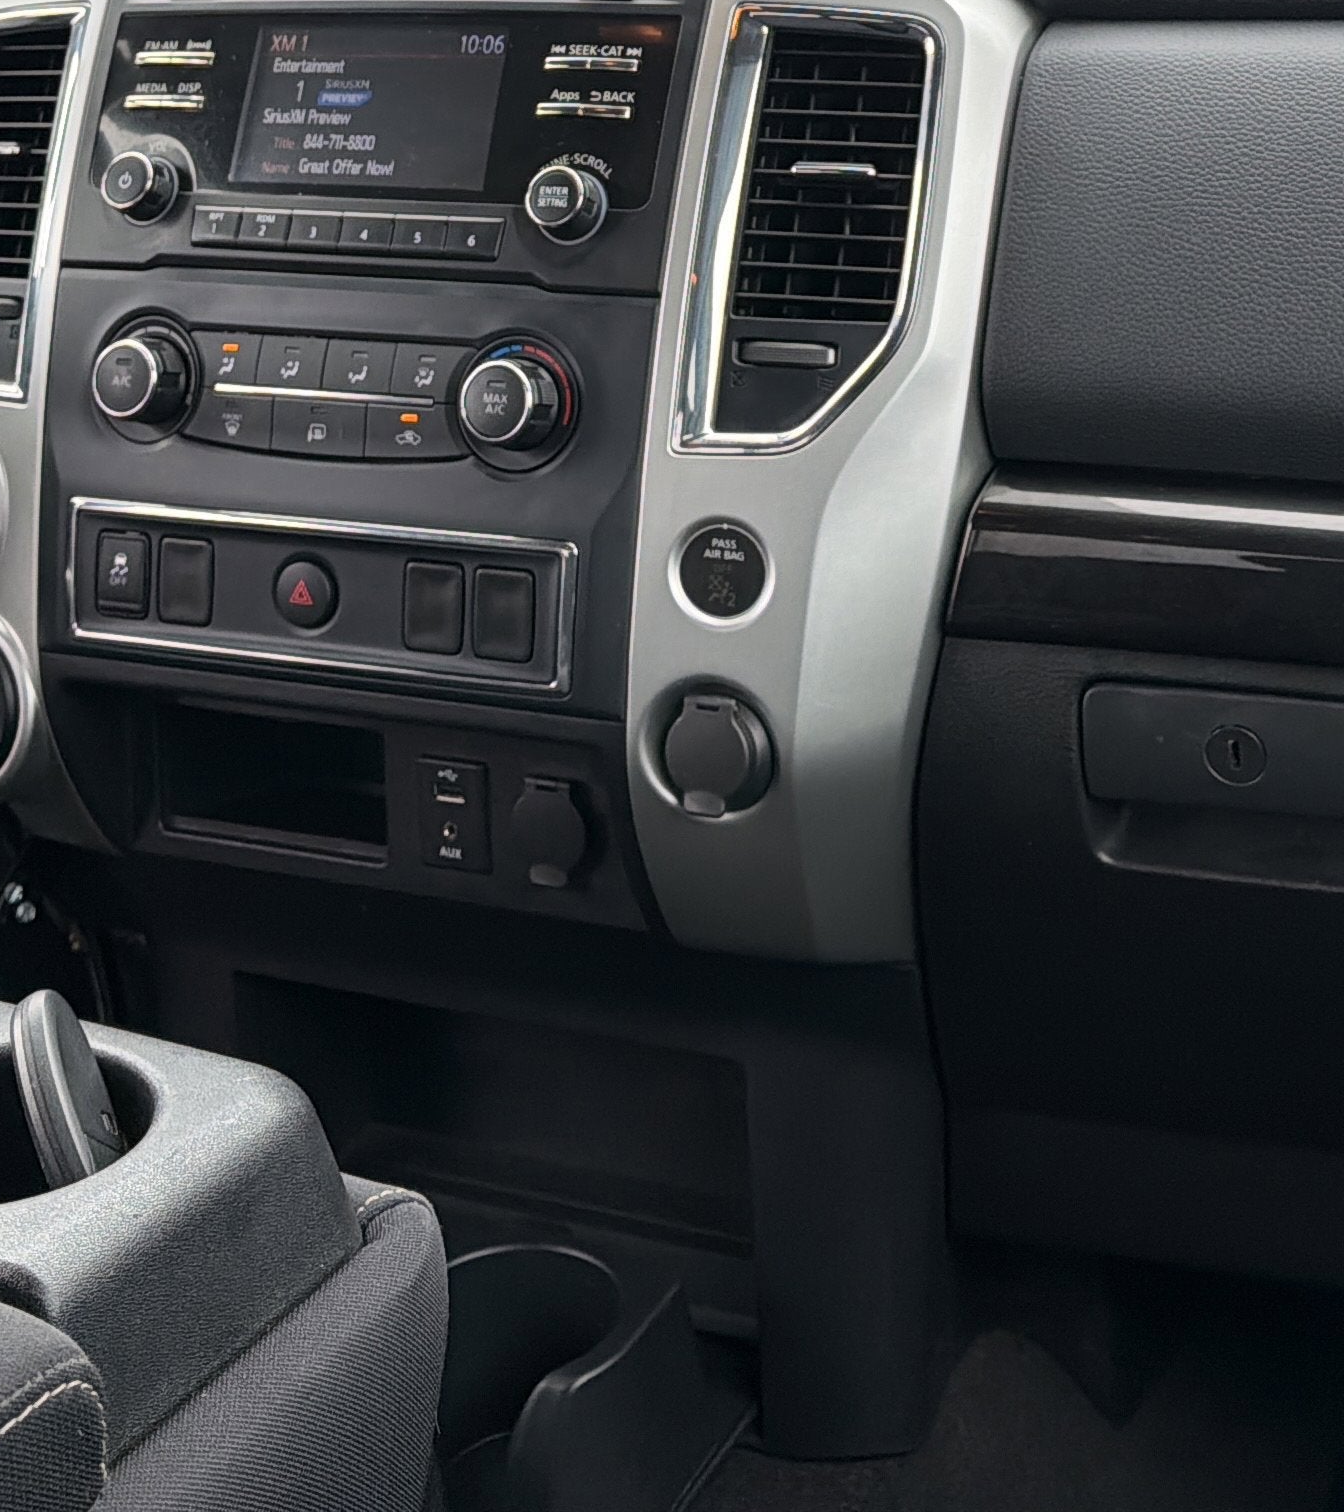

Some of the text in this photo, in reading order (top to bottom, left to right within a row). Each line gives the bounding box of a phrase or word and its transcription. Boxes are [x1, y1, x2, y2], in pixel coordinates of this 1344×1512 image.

[271, 35, 296, 52] XM
[460, 35, 505, 54] 10:06
[273, 57, 345, 74] Entertainment
[135, 83, 168, 93] MEDIA
[297, 80, 305, 102] 1
[550, 88, 580, 101] Apps
[602, 91, 636, 103] BACK
[263, 108, 351, 126] SiriusXM Preview
[303, 134, 376, 151] 844-711-8800
[298, 157, 329, 175] Great
[333, 158, 364, 176] Offer
[366, 160, 395, 177] Now!
[539, 186, 568, 196] ENTER
[537, 198, 568, 208] SETTING
[211, 223, 217, 234] 1
[258, 224, 267, 237] 2
[309, 226, 317, 239] 3
[360, 229, 369, 241] 4
[414, 231, 422, 244] 5
[467, 235, 476, 248] 6
[111, 375, 132, 388] A/C
[483, 392, 508, 404] MAX
[485, 404, 505, 416] A/C
[711, 538, 737, 549] PASS
[703, 548, 745, 562] AIR BAG
[439, 846, 463, 859] AUX
